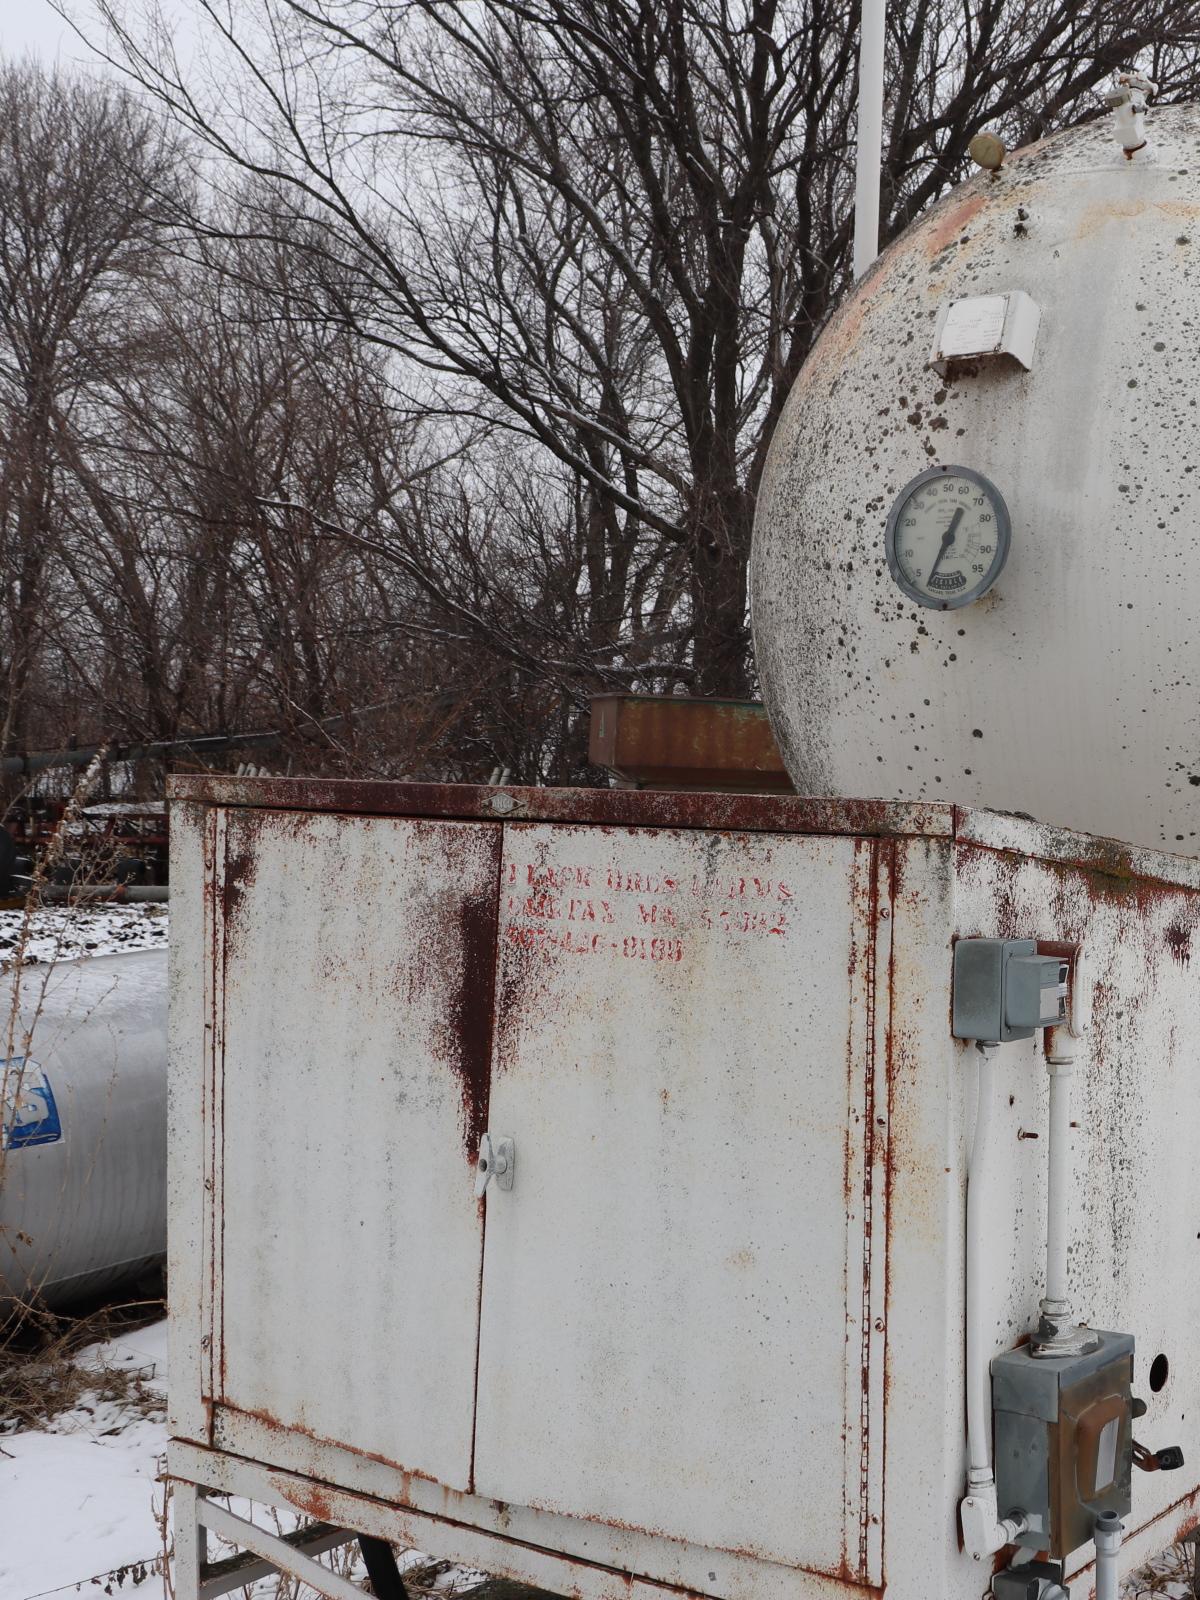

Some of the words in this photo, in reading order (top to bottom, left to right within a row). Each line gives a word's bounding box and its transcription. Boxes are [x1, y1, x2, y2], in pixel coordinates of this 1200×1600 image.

[943, 484, 954, 493] 50
[958, 486, 970, 495] 60
[973, 497, 984, 506] 70
[904, 517, 916, 527] 20
[979, 513, 991, 523] 80
[980, 545, 992, 554] 90
[916, 568, 922, 577] 5
[972, 564, 984, 573] 95
